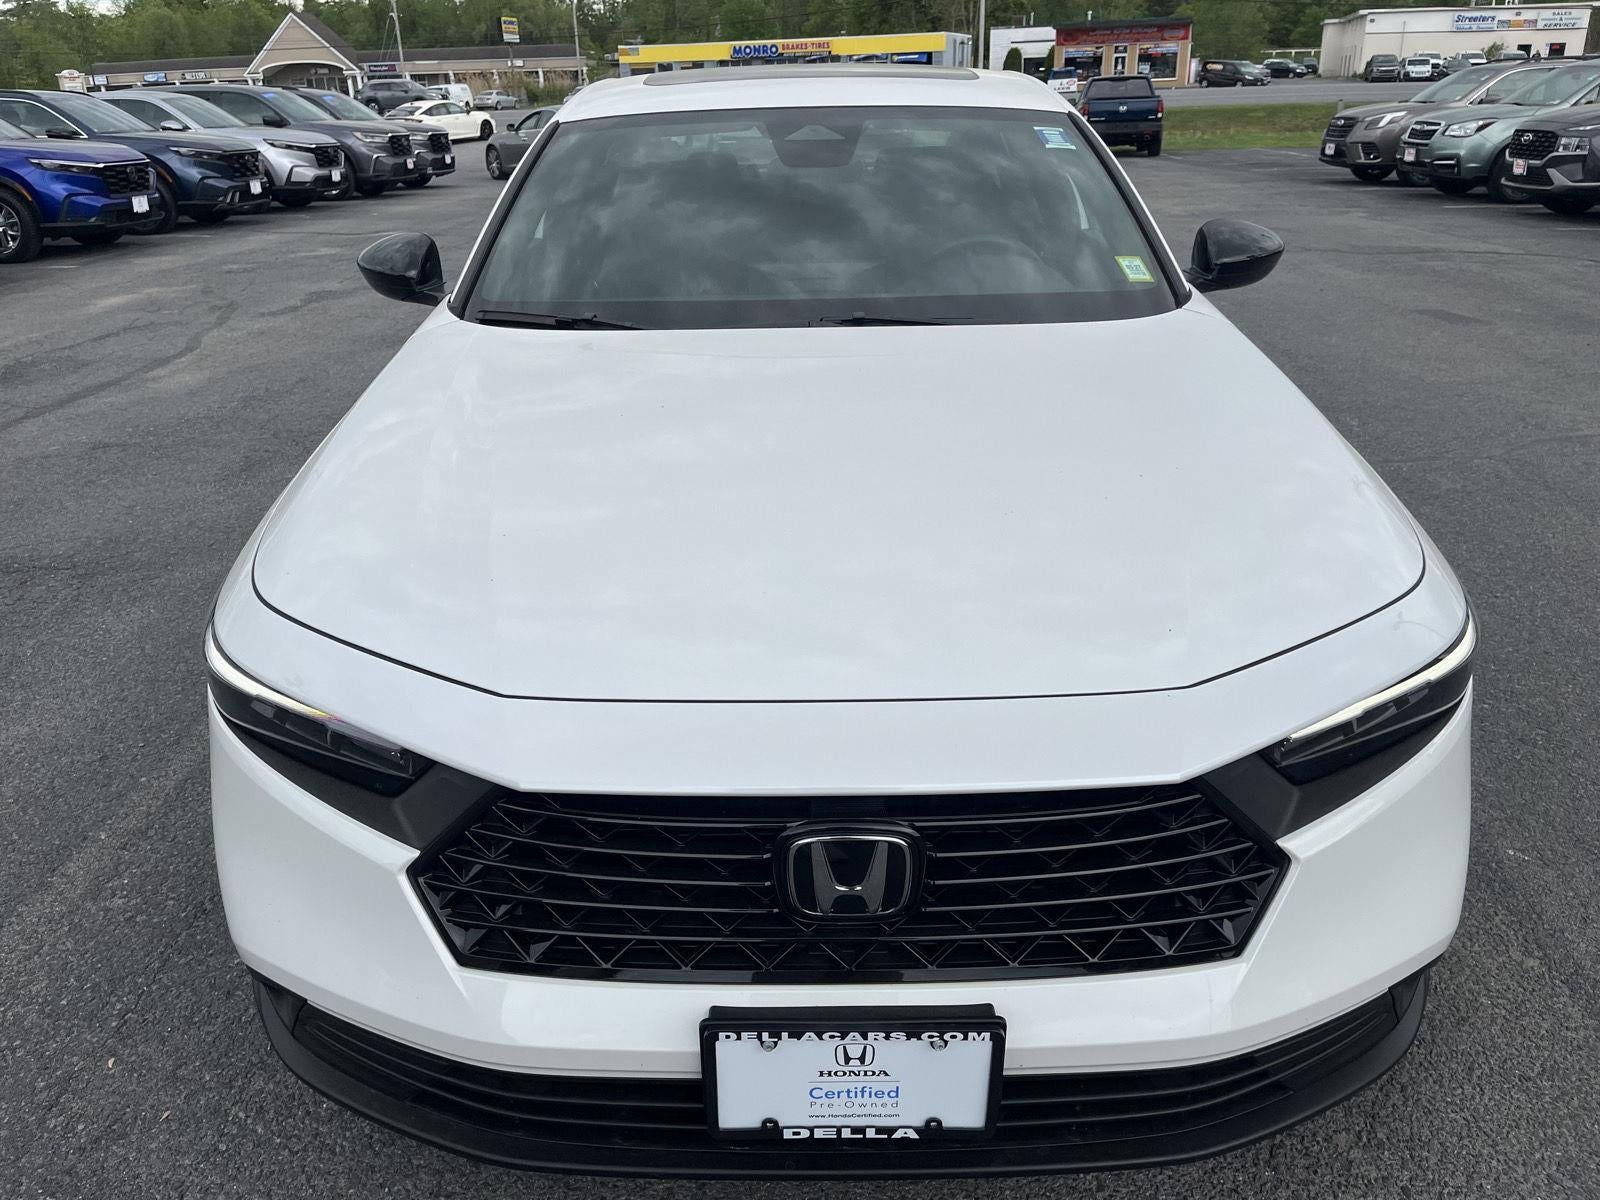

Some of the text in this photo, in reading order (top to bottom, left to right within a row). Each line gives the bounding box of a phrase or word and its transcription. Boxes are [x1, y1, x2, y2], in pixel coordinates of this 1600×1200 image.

[1455, 14, 1497, 23] Streeters
[732, 44, 780, 58] MONRO
[718, 1031, 991, 1042] DELLACARS.COM
[808, 1085, 900, 1100] Certified
[809, 1100, 899, 1109] Pre-Owned
[782, 1127, 920, 1140] DELLA
